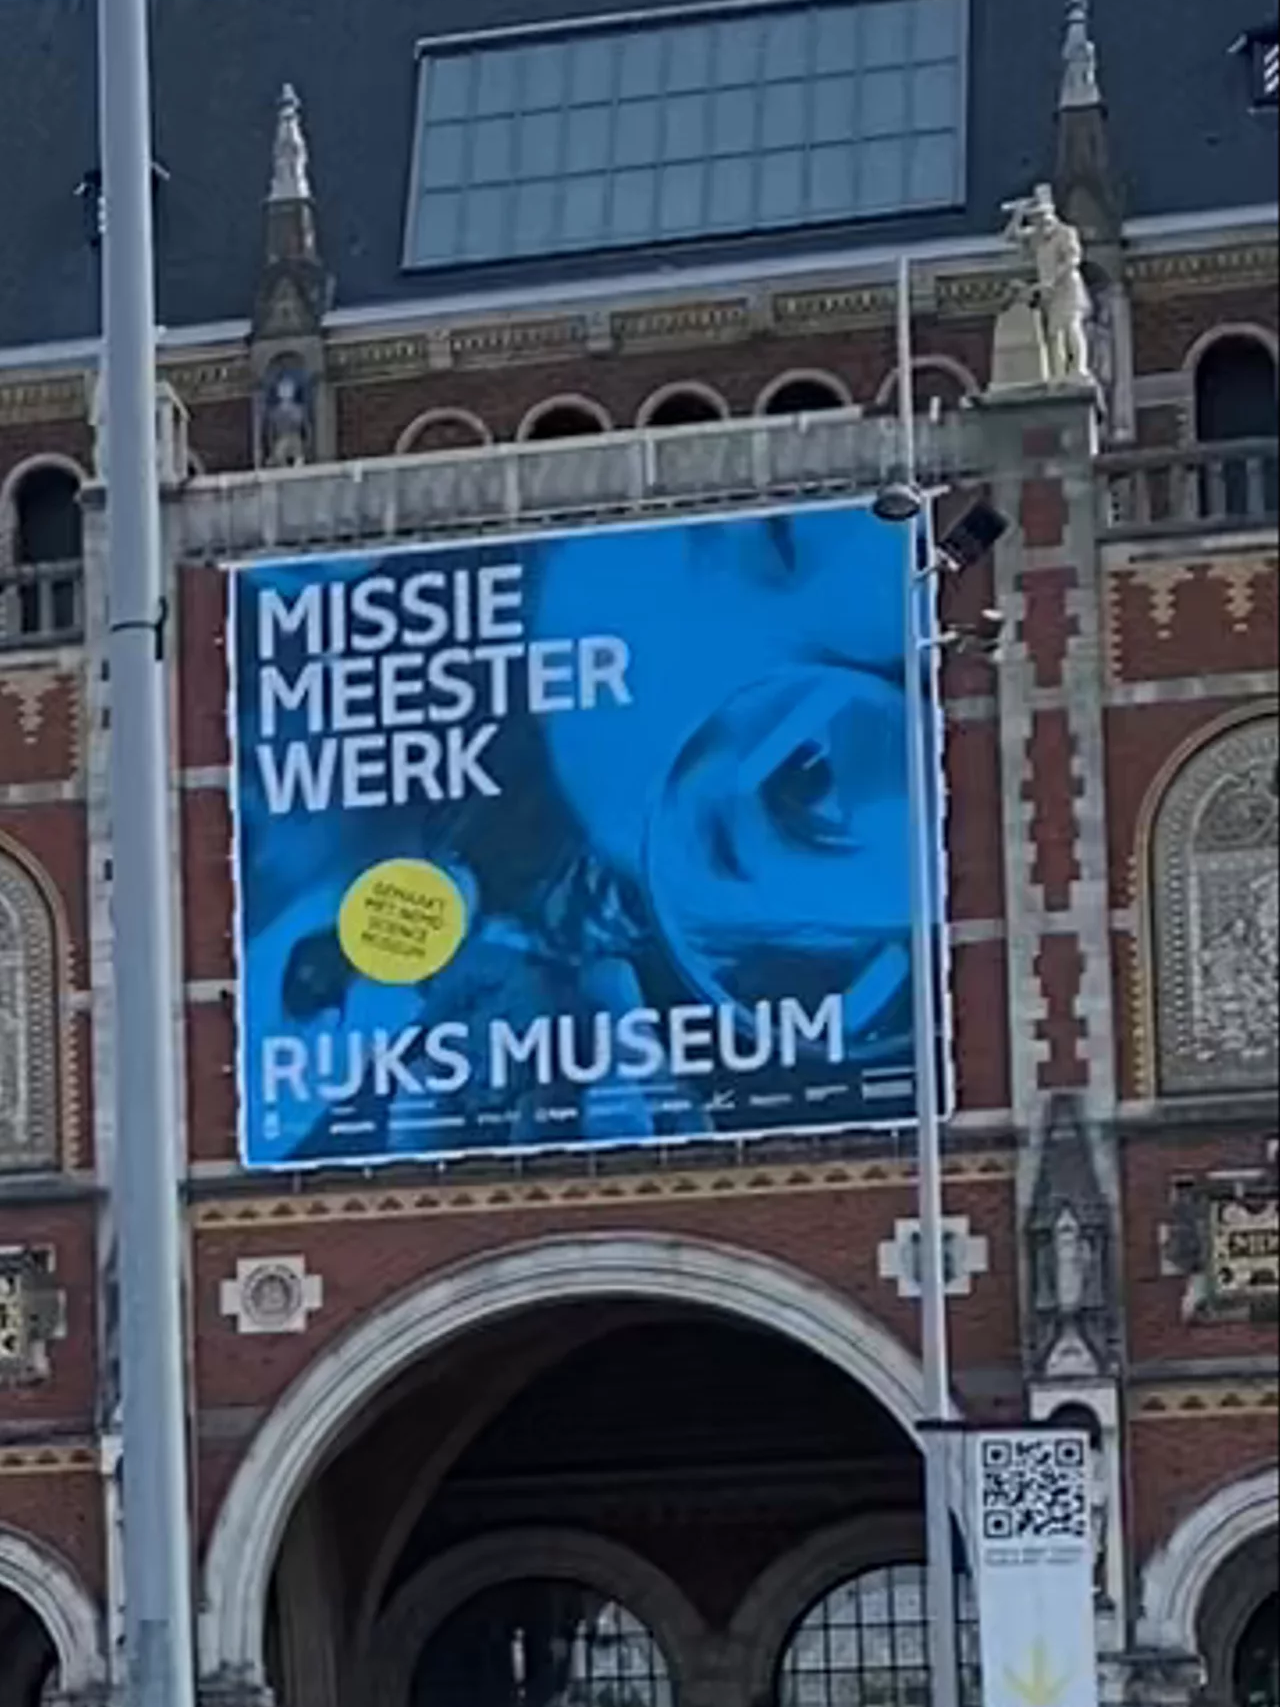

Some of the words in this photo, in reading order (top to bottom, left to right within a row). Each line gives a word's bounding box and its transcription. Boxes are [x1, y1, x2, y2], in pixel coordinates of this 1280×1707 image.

[258, 564, 524, 660] MISSIE
[260, 635, 634, 738] MEESTER
[255, 723, 502, 814] WERK
[261, 1021, 471, 1104] RIJKS
[489, 993, 844, 1089] MUSEUM
